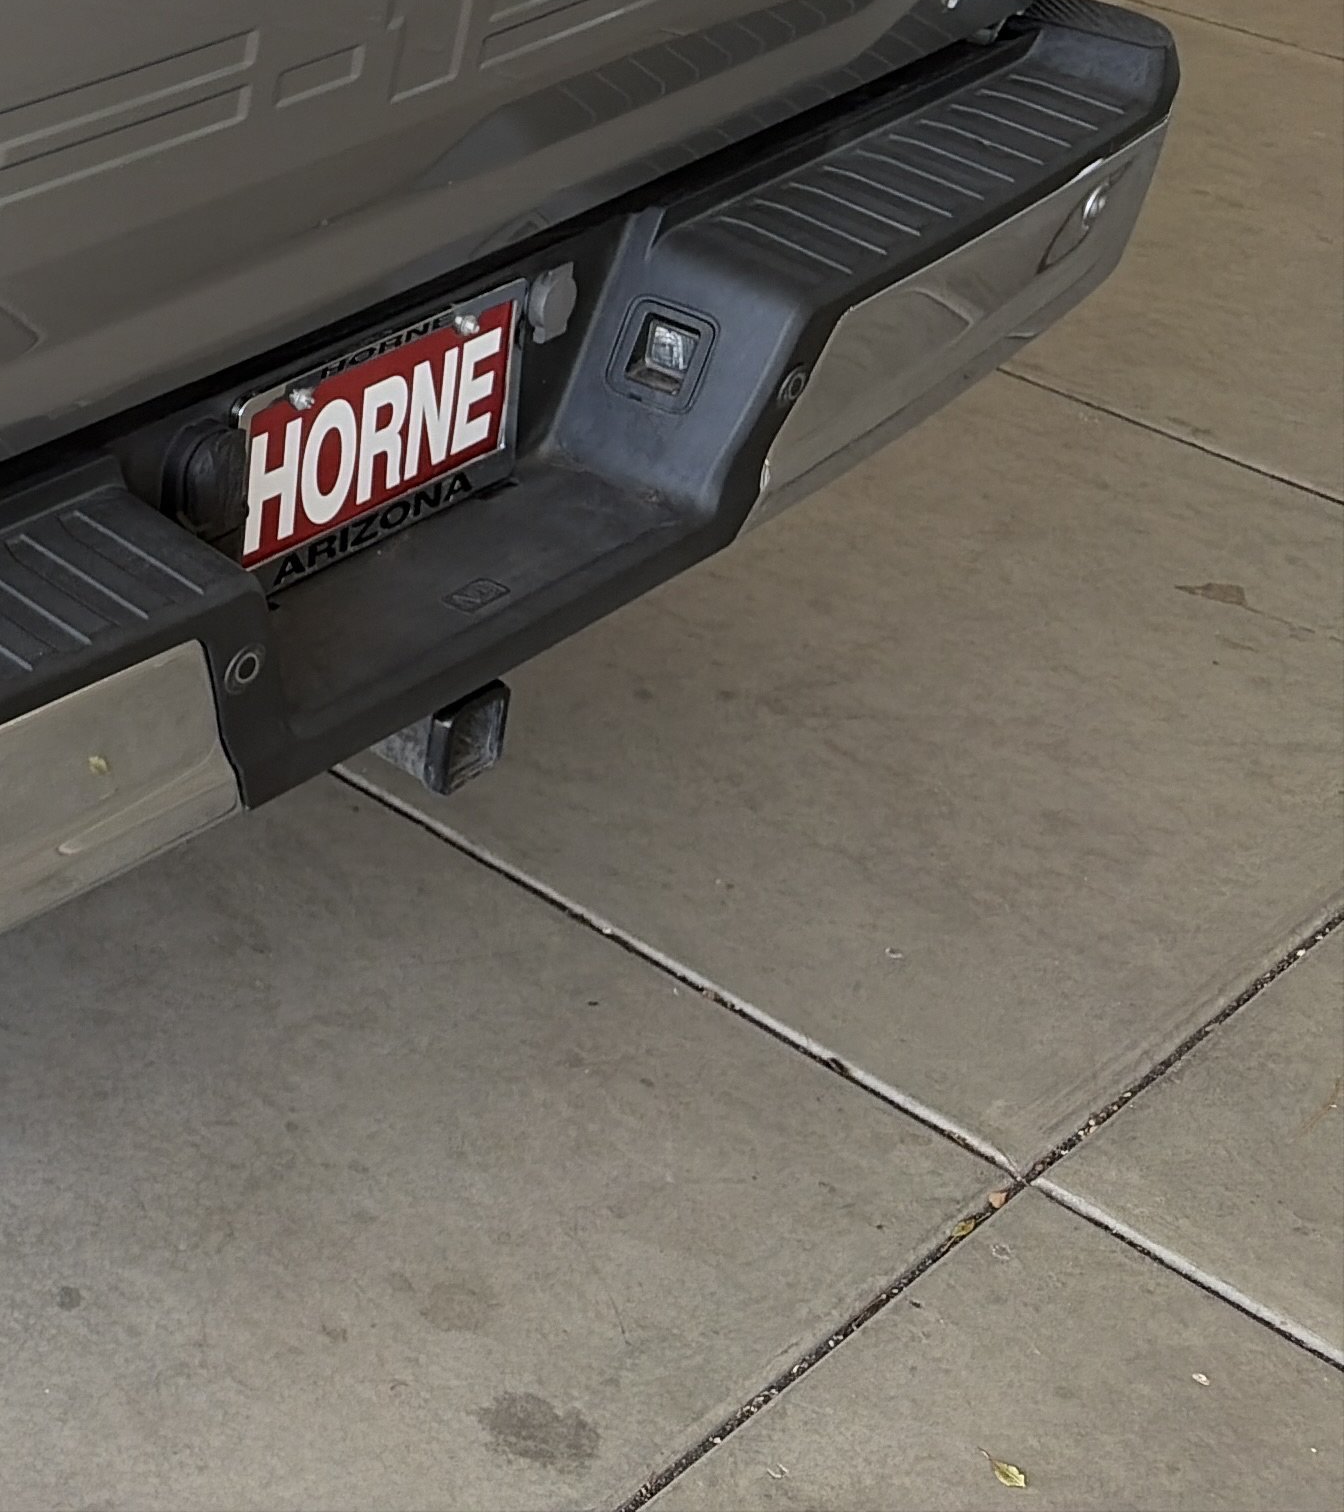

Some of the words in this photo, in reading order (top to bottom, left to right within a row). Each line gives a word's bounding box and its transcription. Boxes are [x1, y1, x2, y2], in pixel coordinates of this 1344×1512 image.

[320, 311, 455, 379] HORNE
[243, 327, 503, 557] HORNE
[273, 470, 474, 587] ARIZONA
